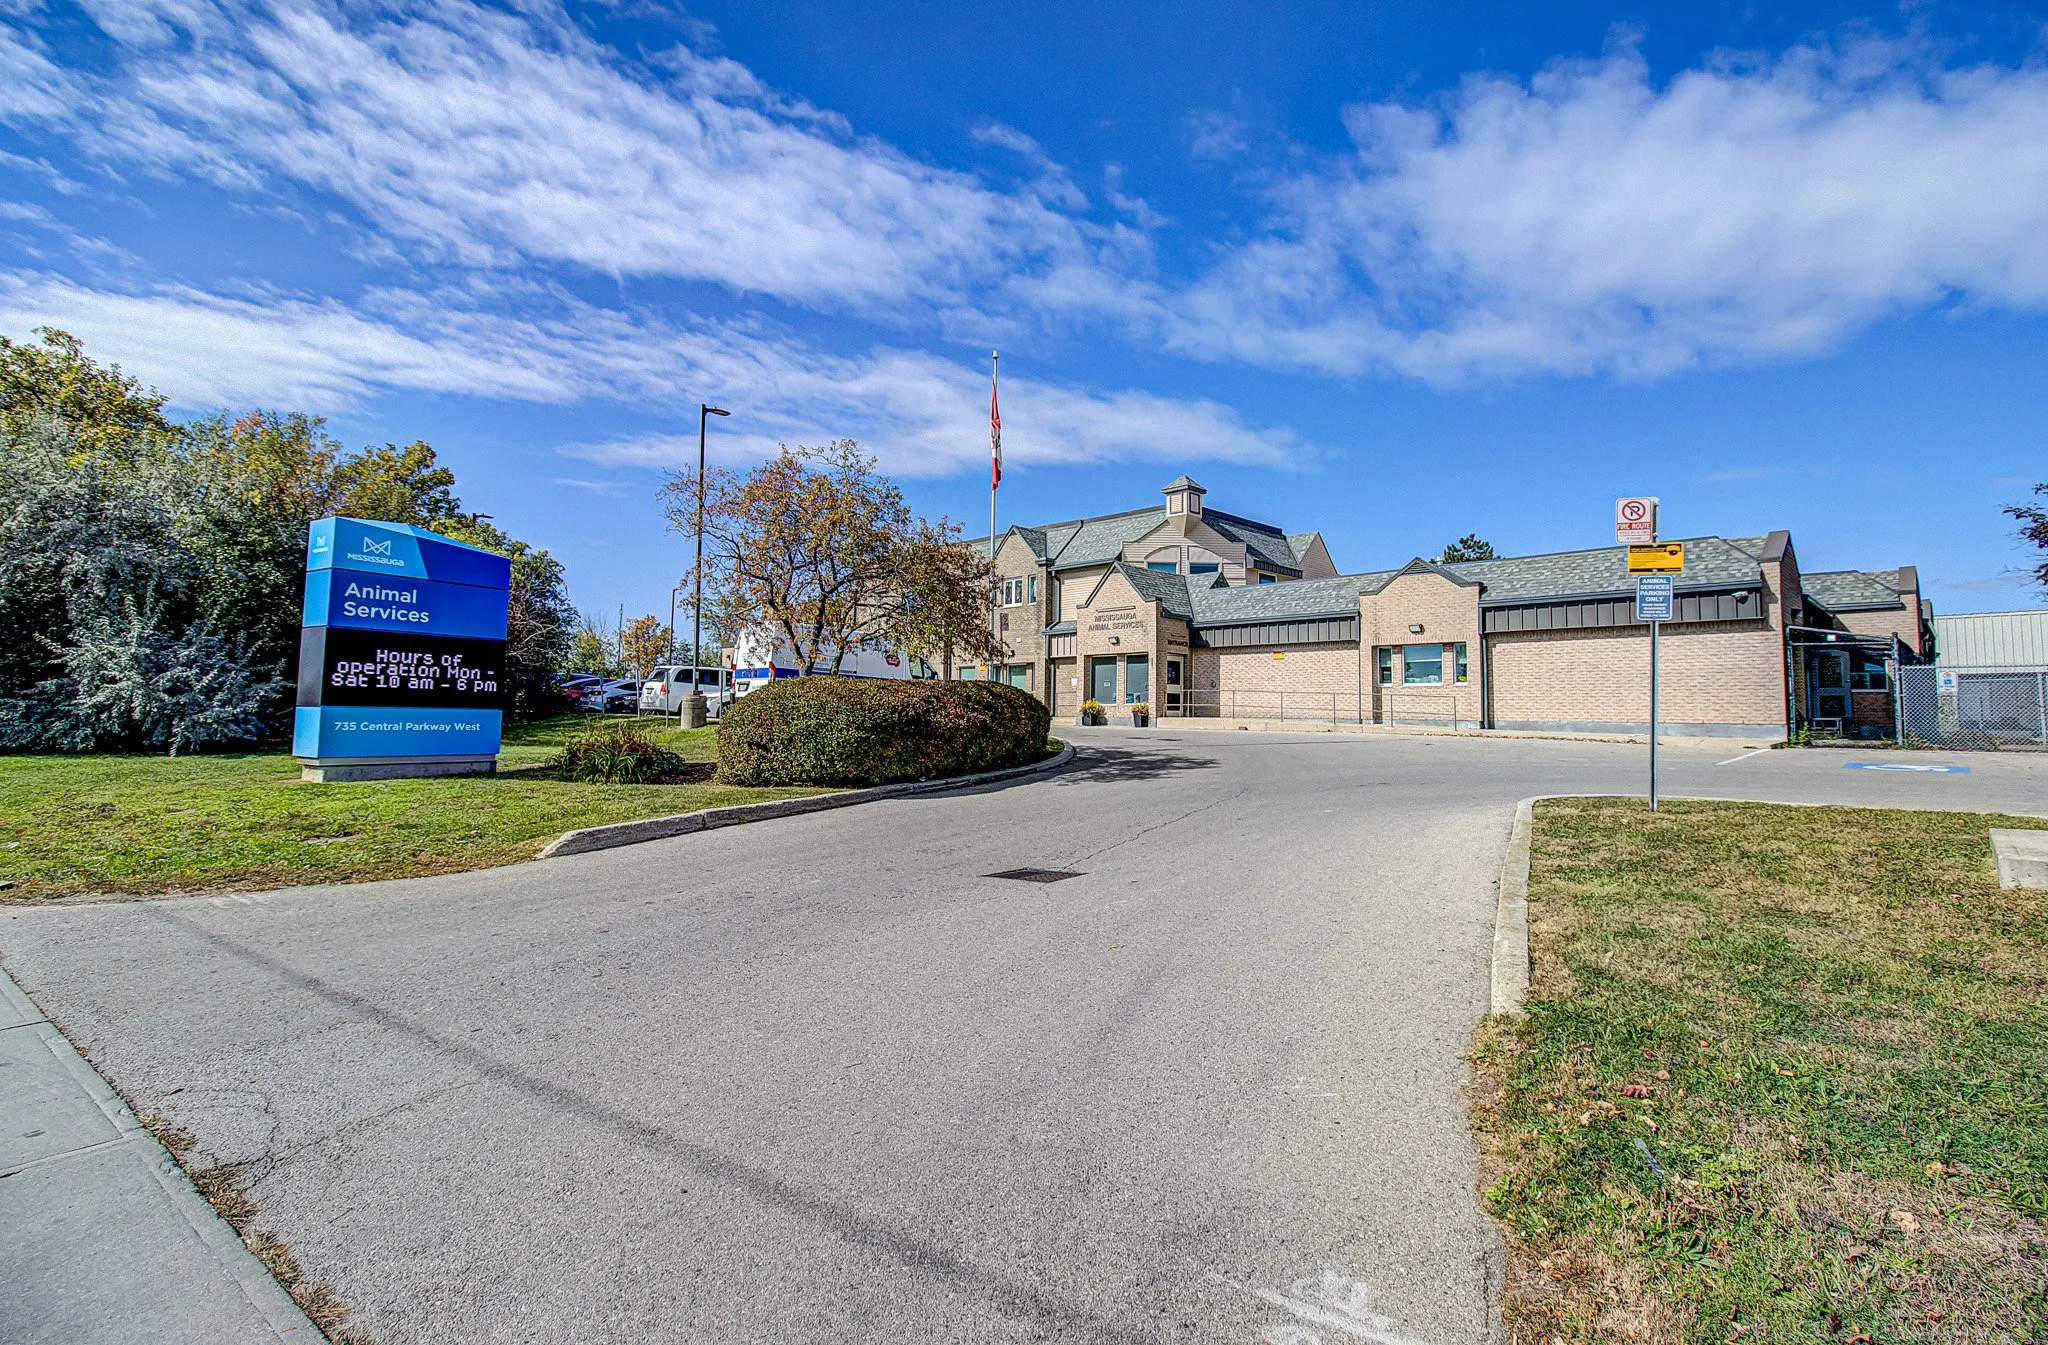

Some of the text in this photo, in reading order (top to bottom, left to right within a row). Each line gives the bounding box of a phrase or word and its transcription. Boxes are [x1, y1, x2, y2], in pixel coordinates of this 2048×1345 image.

[344, 582, 417, 604] Animal
[343, 601, 429, 623] Services
[1094, 612, 1137, 622] MISSISSAUGA
[1088, 621, 1144, 631] ANIMAL SERVICES
[376, 649, 463, 667] Hours of
[336, 661, 440, 678] operation
[447, 667, 481, 680] Mon
[331, 673, 368, 688] Sat
[376, 675, 400, 689] 10
[408, 677, 434, 690] am
[457, 678, 467, 691] 6
[474, 680, 498, 692] pm
[334, 721, 480, 733] 735 Central Parkway West
